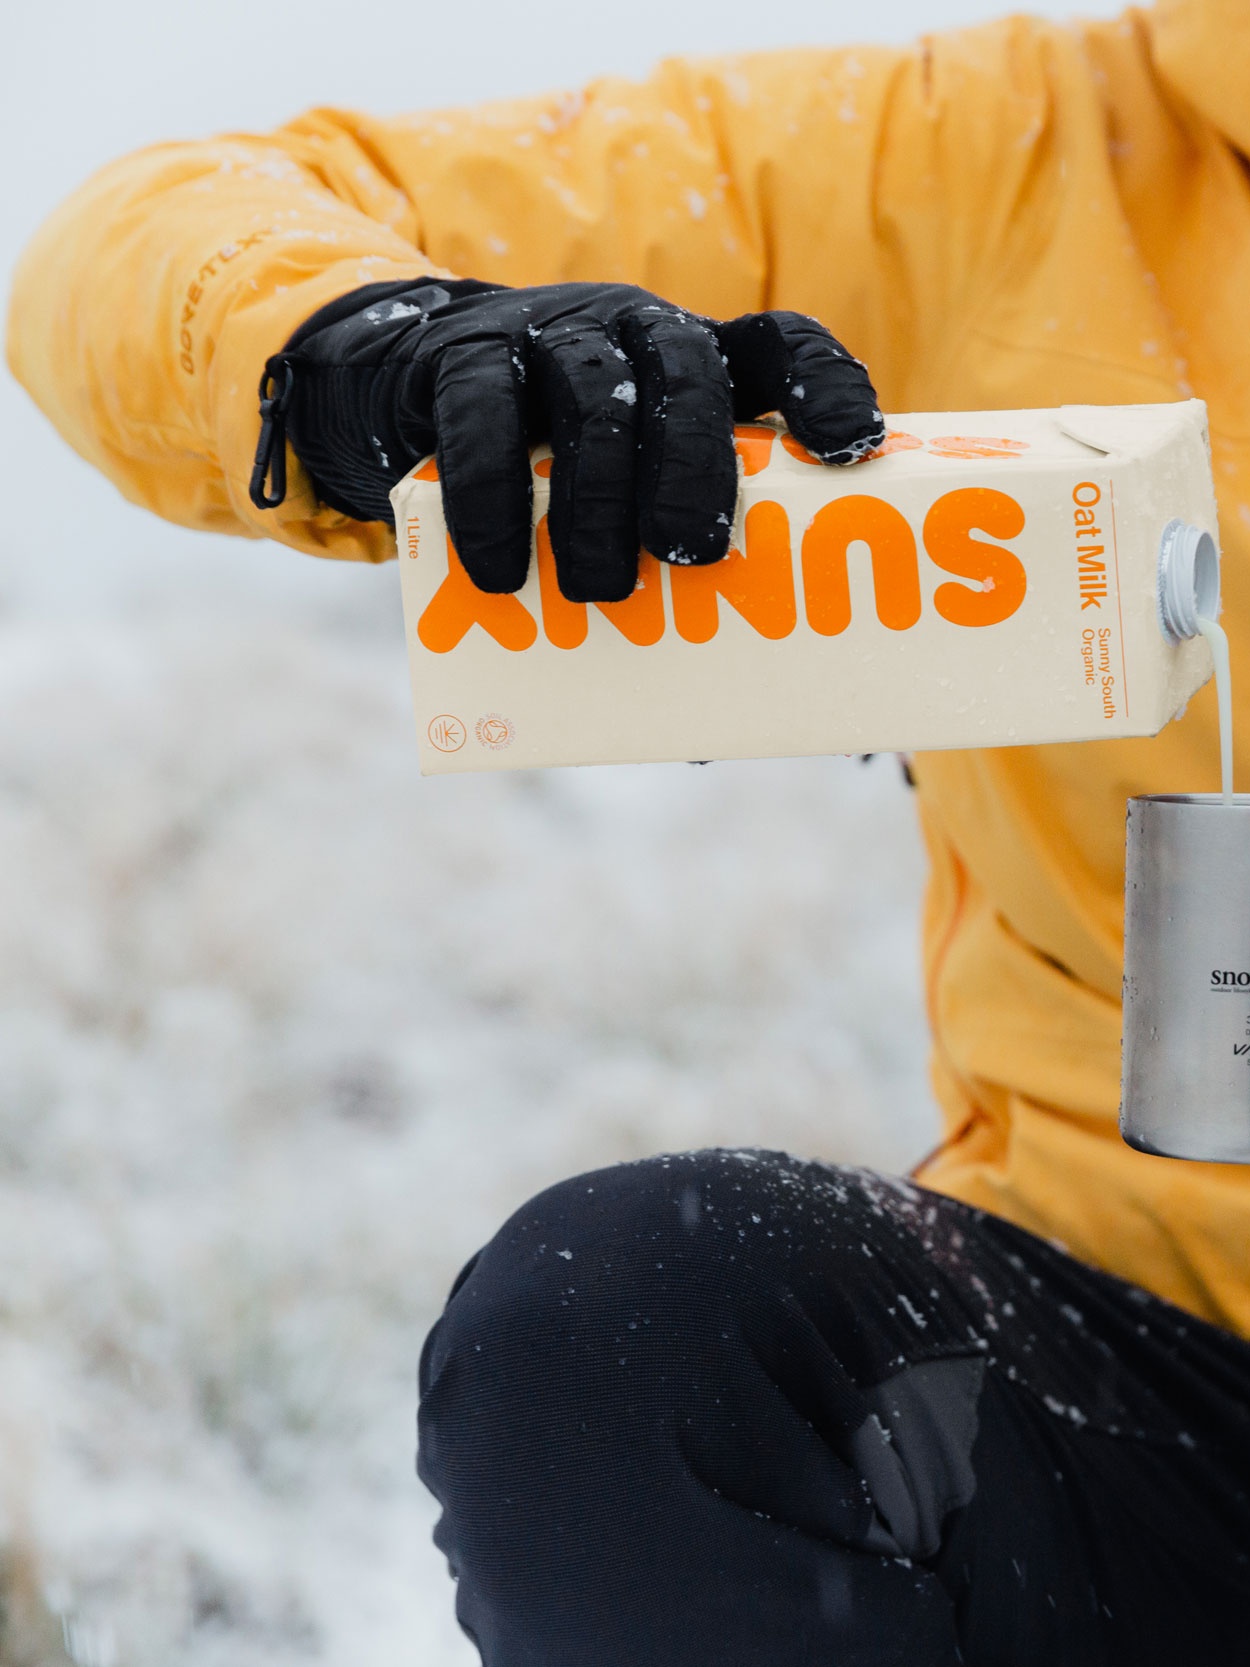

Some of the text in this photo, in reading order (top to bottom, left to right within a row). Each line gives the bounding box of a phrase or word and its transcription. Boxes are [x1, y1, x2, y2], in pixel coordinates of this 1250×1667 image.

[407, 526, 421, 559] Litre
[1071, 481, 1108, 611] Oat Milk
[1080, 628, 1096, 686] Organic
[1096, 627, 1117, 719] Sunny South
